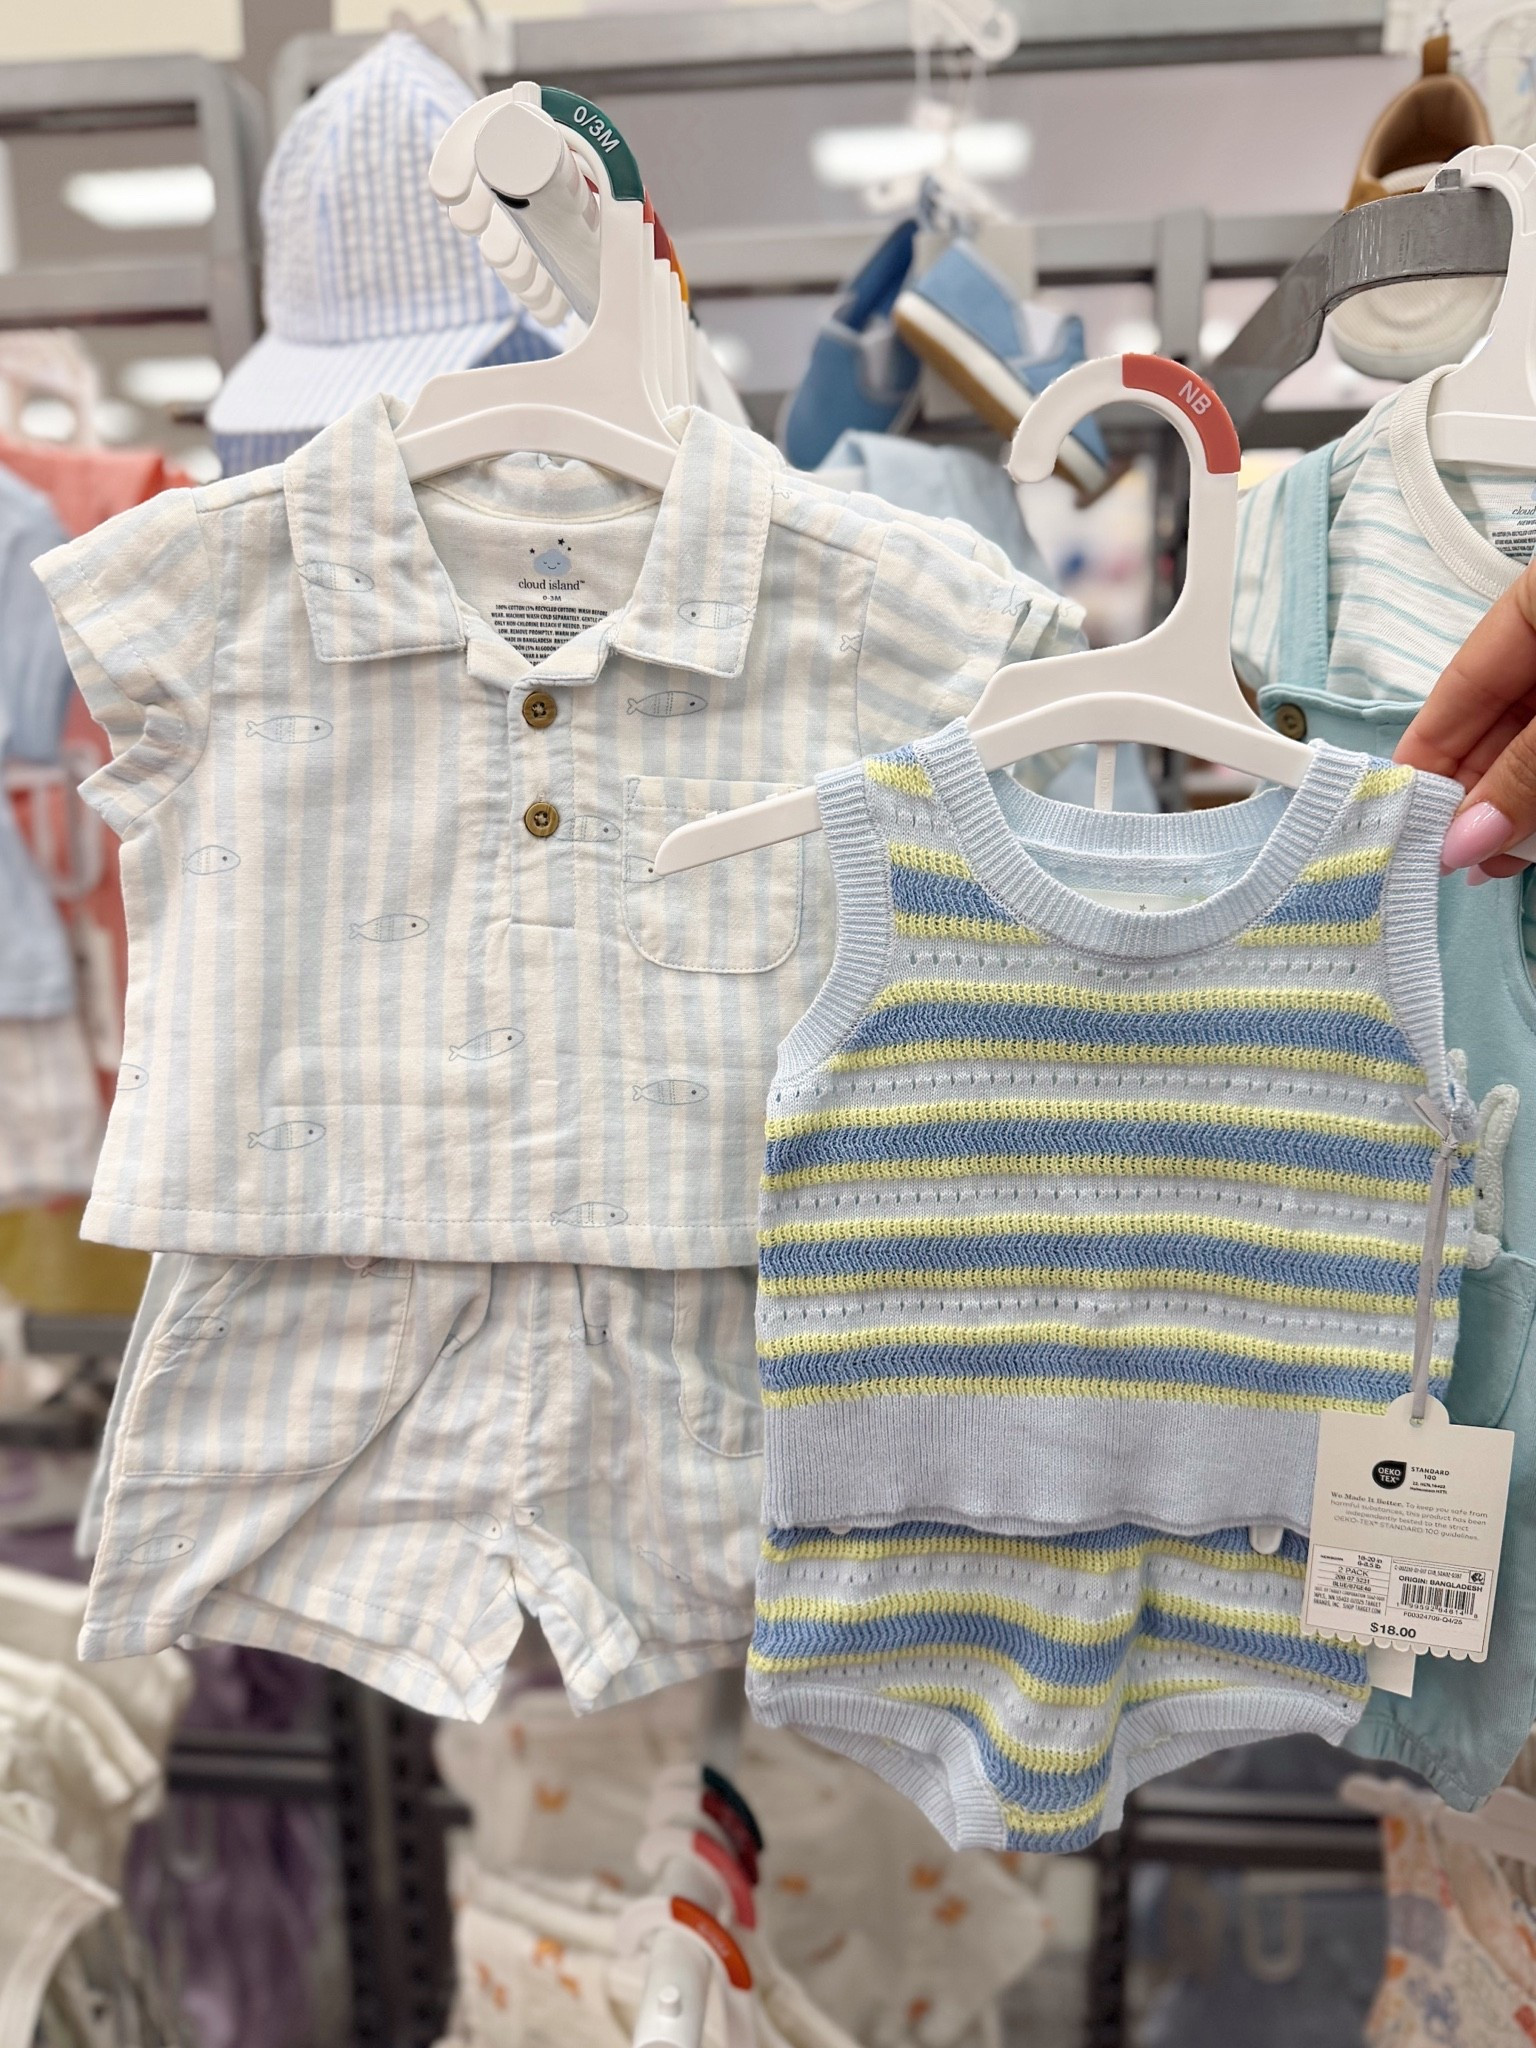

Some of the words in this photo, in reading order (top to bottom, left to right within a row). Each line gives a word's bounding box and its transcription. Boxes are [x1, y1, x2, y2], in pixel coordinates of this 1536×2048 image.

[574, 105, 620, 153] 0/3M
[1178, 380, 1212, 415] NB
[518, 578, 546, 590] cloud
[1378, 1467, 1401, 1477] OEKO
[1411, 1466, 1450, 1476] STANDARD
[1330, 1499, 1360, 1509] harmful
[1406, 1510, 1420, 1518] this
[1421, 1512, 1451, 1522] product
[1468, 1518, 1487, 1526] been
[1331, 1491, 1343, 1499] We
[1344, 1493, 1366, 1502] Made
[1416, 1503, 1434, 1512] keep
[1451, 1508, 1468, 1516] safe
[1469, 1510, 1488, 1519] from
[1345, 1509, 1398, 1523] independently
[1399, 1517, 1423, 1526] tested
[1449, 1523, 1469, 1532] strict
[1379, 1521, 1424, 1534] STANDARD
[1425, 1527, 1440, 1536] 100
[1345, 1567, 1369, 1577] PACK
[1398, 1575, 1429, 1585] ORIGIN:
[1429, 1579, 1483, 1592] BANGLADESH
[1365, 1599, 1382, 1607] TARGET
[1370, 1621, 1417, 1639] $18.00
